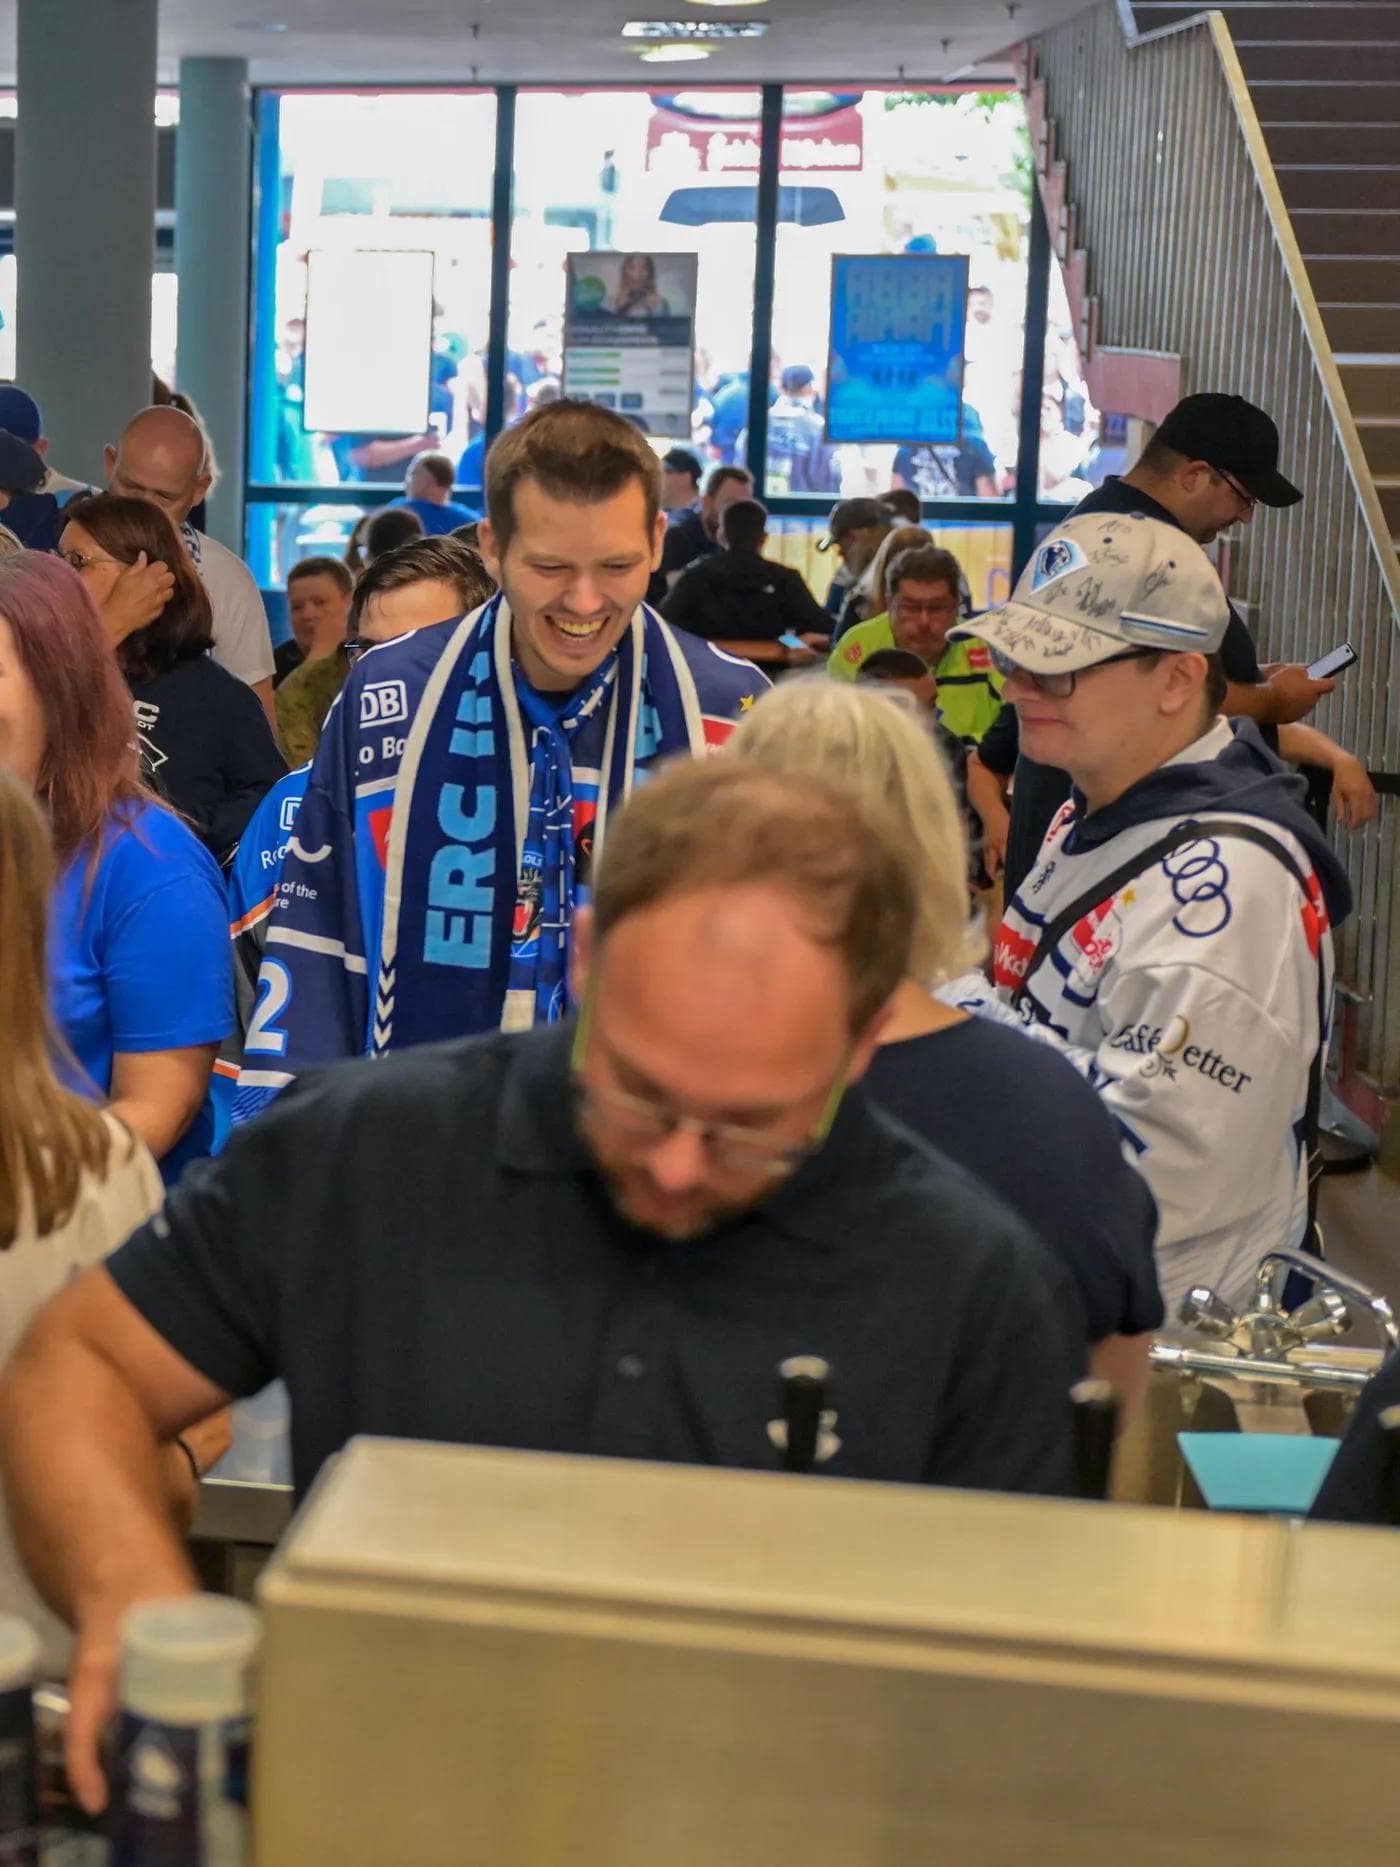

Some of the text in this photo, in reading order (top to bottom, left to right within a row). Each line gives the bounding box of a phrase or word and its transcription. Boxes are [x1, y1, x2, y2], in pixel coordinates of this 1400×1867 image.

[360, 688, 400, 721] DB
[297, 884, 317, 900] the
[424, 782, 496, 969] ERC
